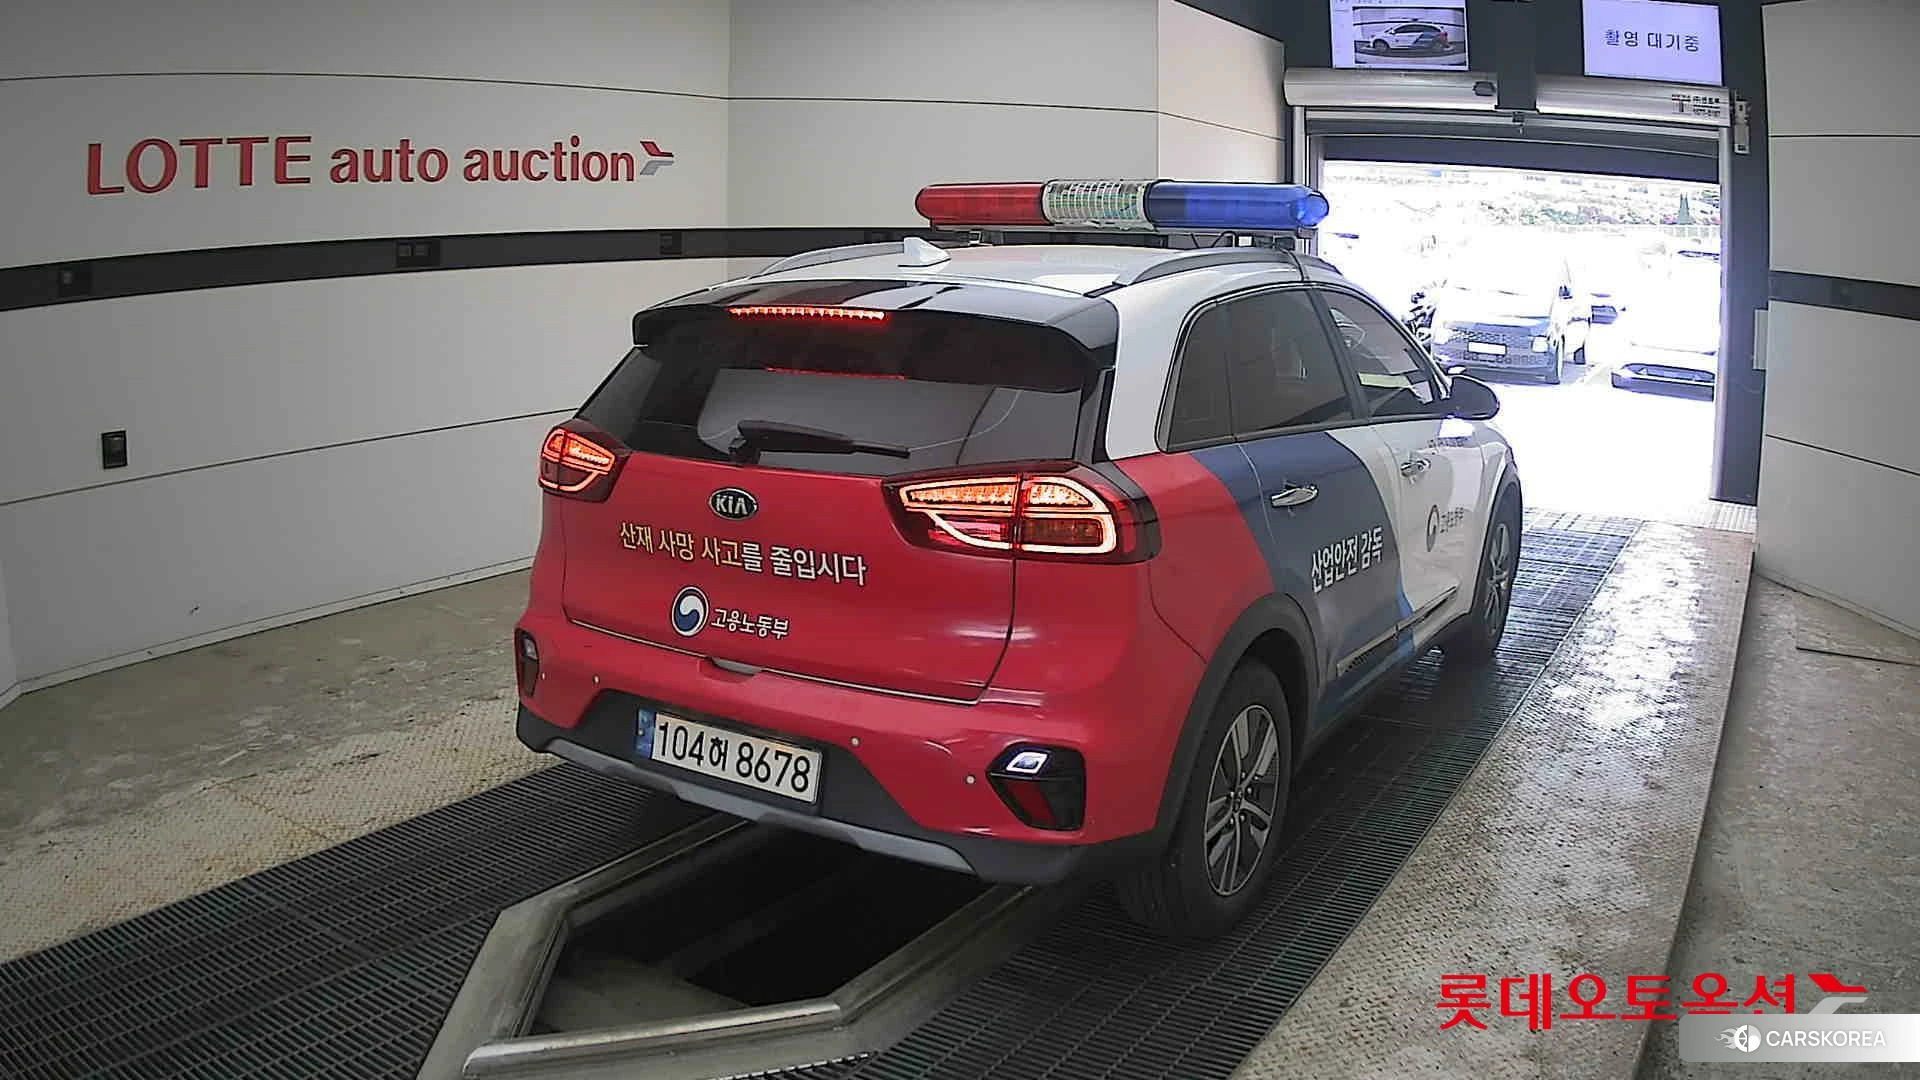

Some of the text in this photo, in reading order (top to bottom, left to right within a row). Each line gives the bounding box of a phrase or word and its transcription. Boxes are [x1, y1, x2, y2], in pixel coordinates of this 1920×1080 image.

[1646, 31, 1699, 52] 대기중
[87, 135, 634, 195] LOTTE auto auction
[716, 494, 748, 515] KIA
[620, 521, 866, 586] 산재 사망 사고를 줄입시다
[1311, 527, 1383, 593] 산업안전 감독
[710, 608, 789, 639] 고용노동부
[659, 722, 810, 793] 104허 8678
